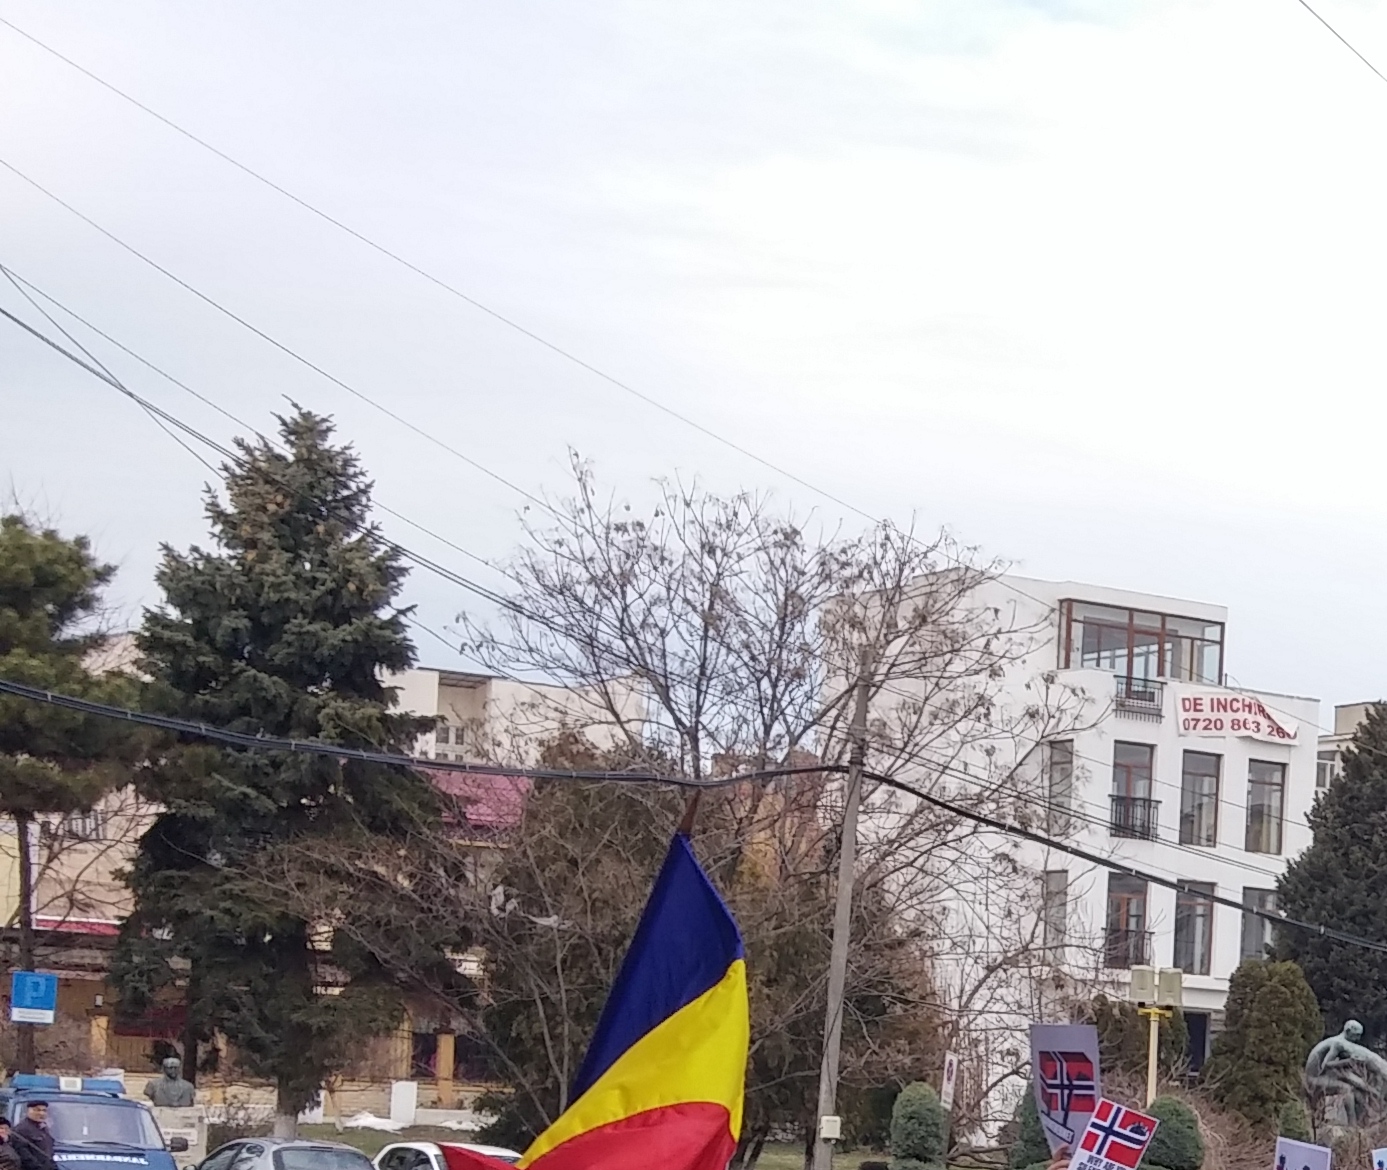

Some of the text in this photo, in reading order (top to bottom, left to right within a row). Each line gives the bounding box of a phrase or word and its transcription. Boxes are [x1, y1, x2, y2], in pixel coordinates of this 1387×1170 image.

[1181, 697, 1272, 720] DE INCHIR
[1182, 718, 1224, 731] 0720
